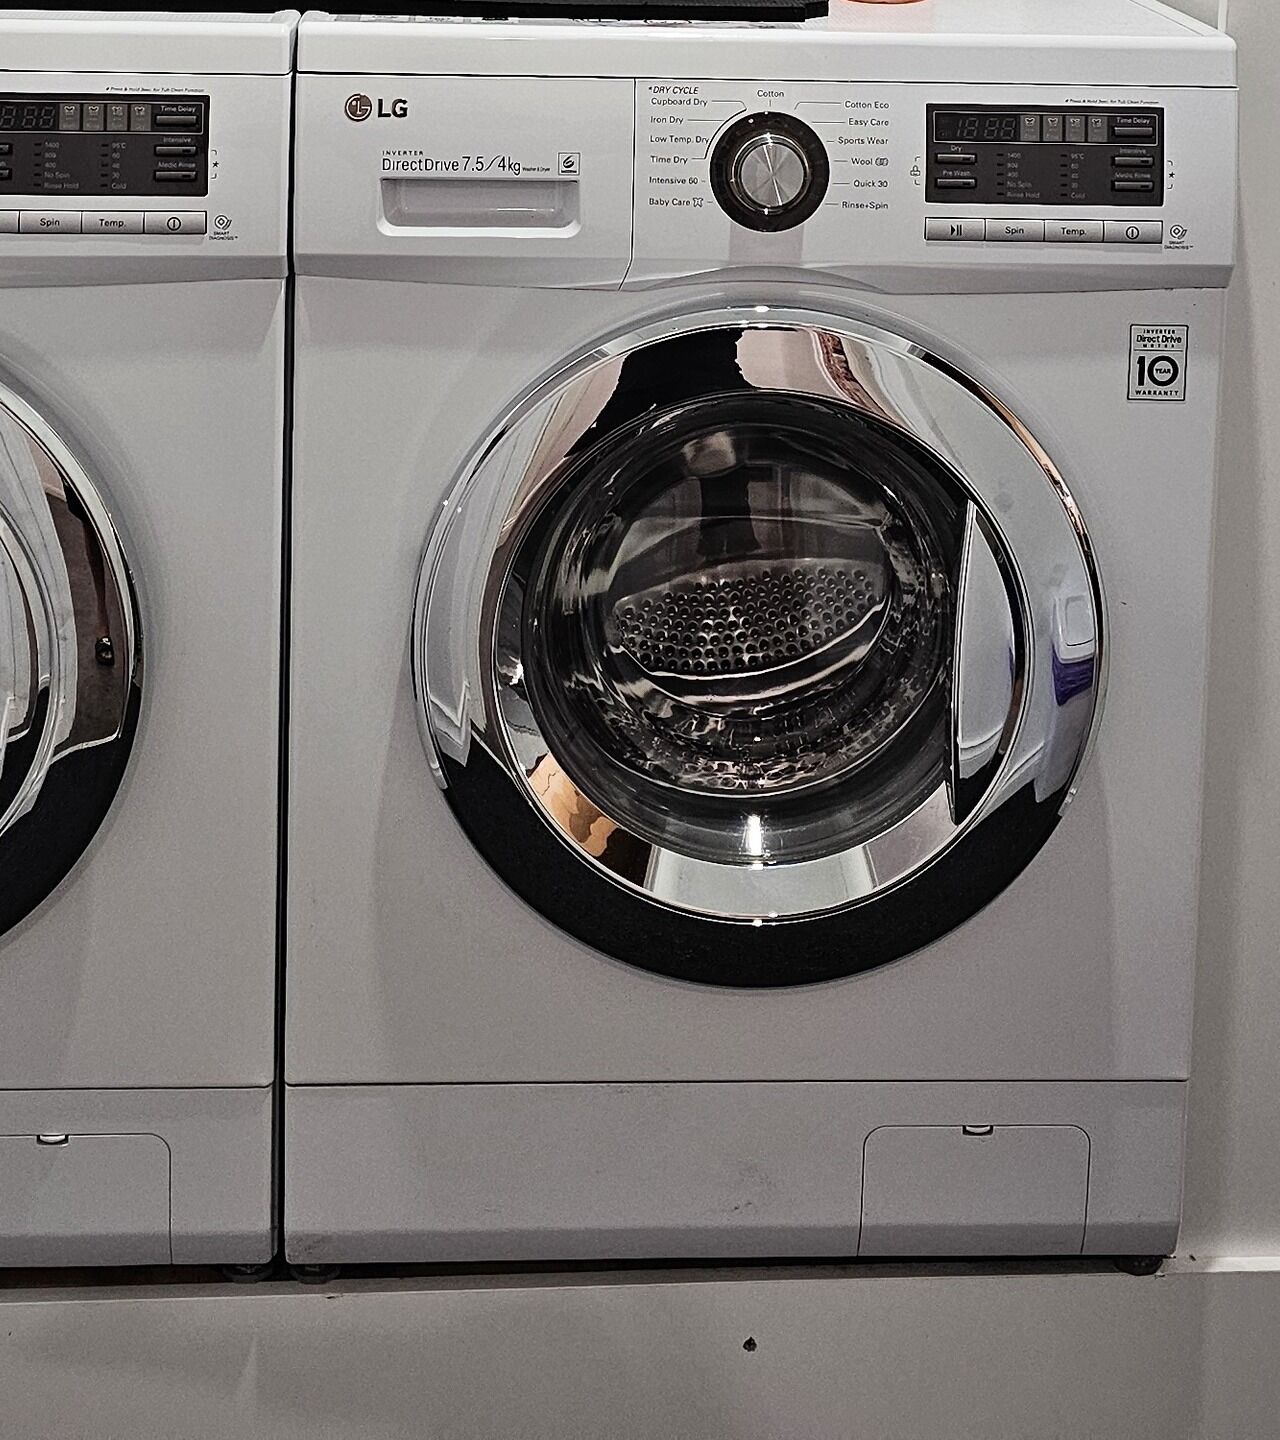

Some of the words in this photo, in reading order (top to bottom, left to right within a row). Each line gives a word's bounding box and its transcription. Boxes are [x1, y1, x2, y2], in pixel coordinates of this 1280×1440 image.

[757, 89, 785, 98] Cotton
[651, 98, 692, 107] Cupboard
[694, 98, 708, 107] Dry
[844, 100, 872, 109] Cotton
[874, 101, 889, 109] Eco
[377, 98, 408, 118] LG
[669, 116, 684, 125] Dry
[848, 118, 867, 128] Easy
[1134, 118, 1150, 126] Delay
[669, 136, 694, 145] Temp.
[695, 136, 710, 145] Dry
[838, 137, 865, 146] Sports
[867, 137, 889, 145] Wear
[650, 156, 671, 164] Time
[673, 156, 688, 165] Dry
[851, 157, 873, 166] Wool
[649, 176, 686, 184] Intensive
[853, 180, 876, 188] Quick
[877, 180, 888, 188] 30
[649, 198, 671, 207] Baby
[842, 201, 889, 210] Rinse+Spin
[39, 218, 60, 228] Spin
[98, 219, 127, 228] Temp.
[1005, 226, 1024, 236] Spin
[1060, 228, 1087, 236] Temp.
[1137, 355, 1179, 386] 10
